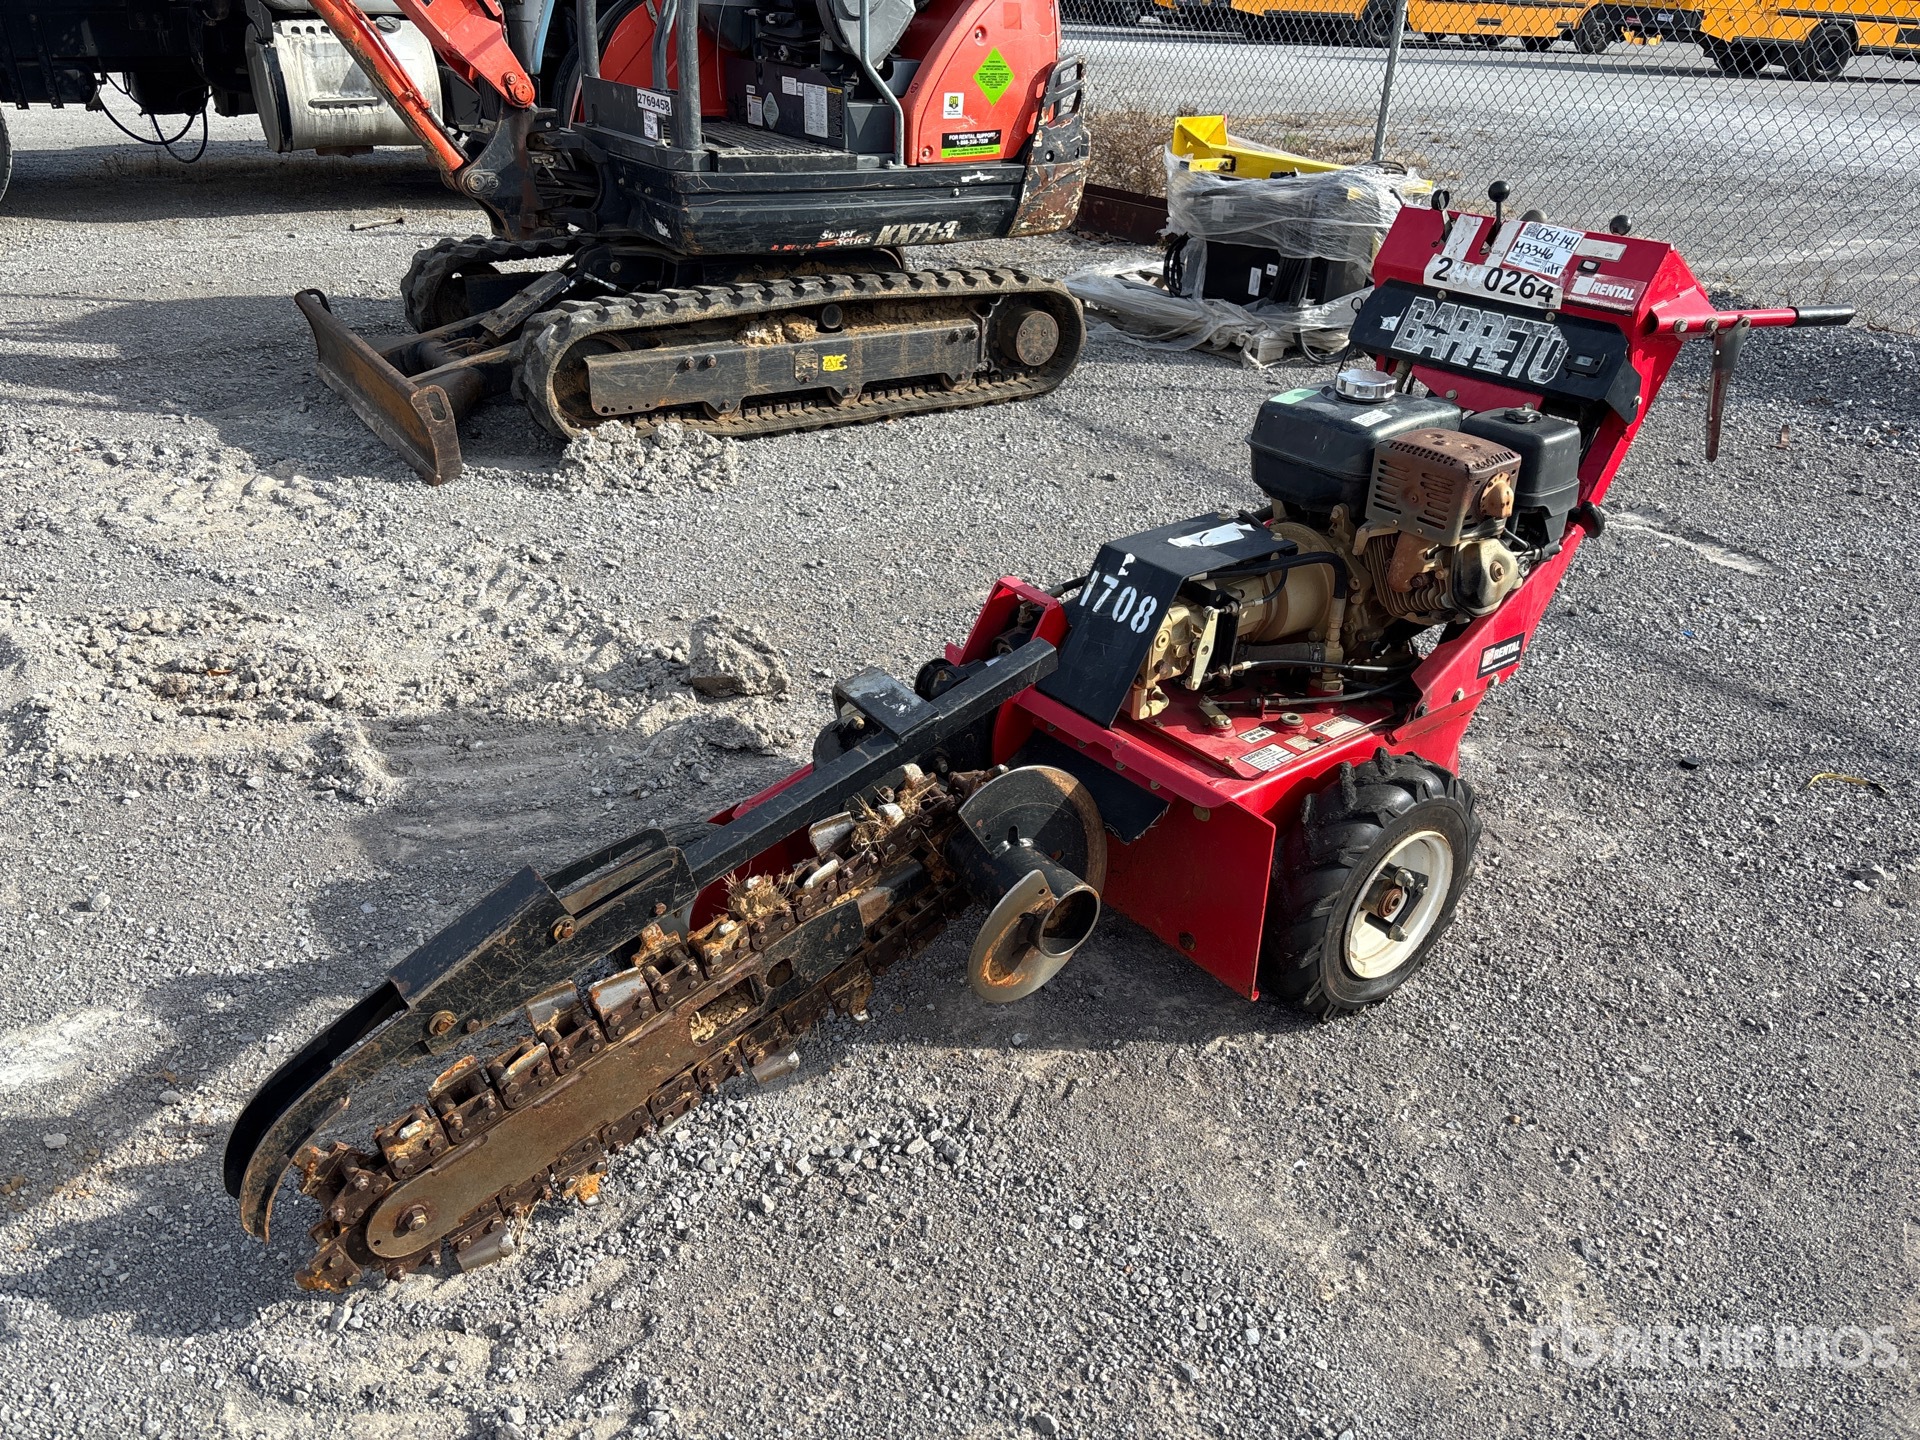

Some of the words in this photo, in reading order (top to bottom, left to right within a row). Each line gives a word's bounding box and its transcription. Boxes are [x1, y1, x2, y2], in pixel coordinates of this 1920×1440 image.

[637, 92, 671, 112] 2769458
[873, 220, 959, 246] KX71-3
[1432, 257, 1554, 302] 20264
[1589, 281, 1635, 301] RENTAL
[1391, 295, 1570, 385] BARRETO
[1079, 570, 1158, 634] 1708
[1493, 640, 1520, 660] RENTAL
